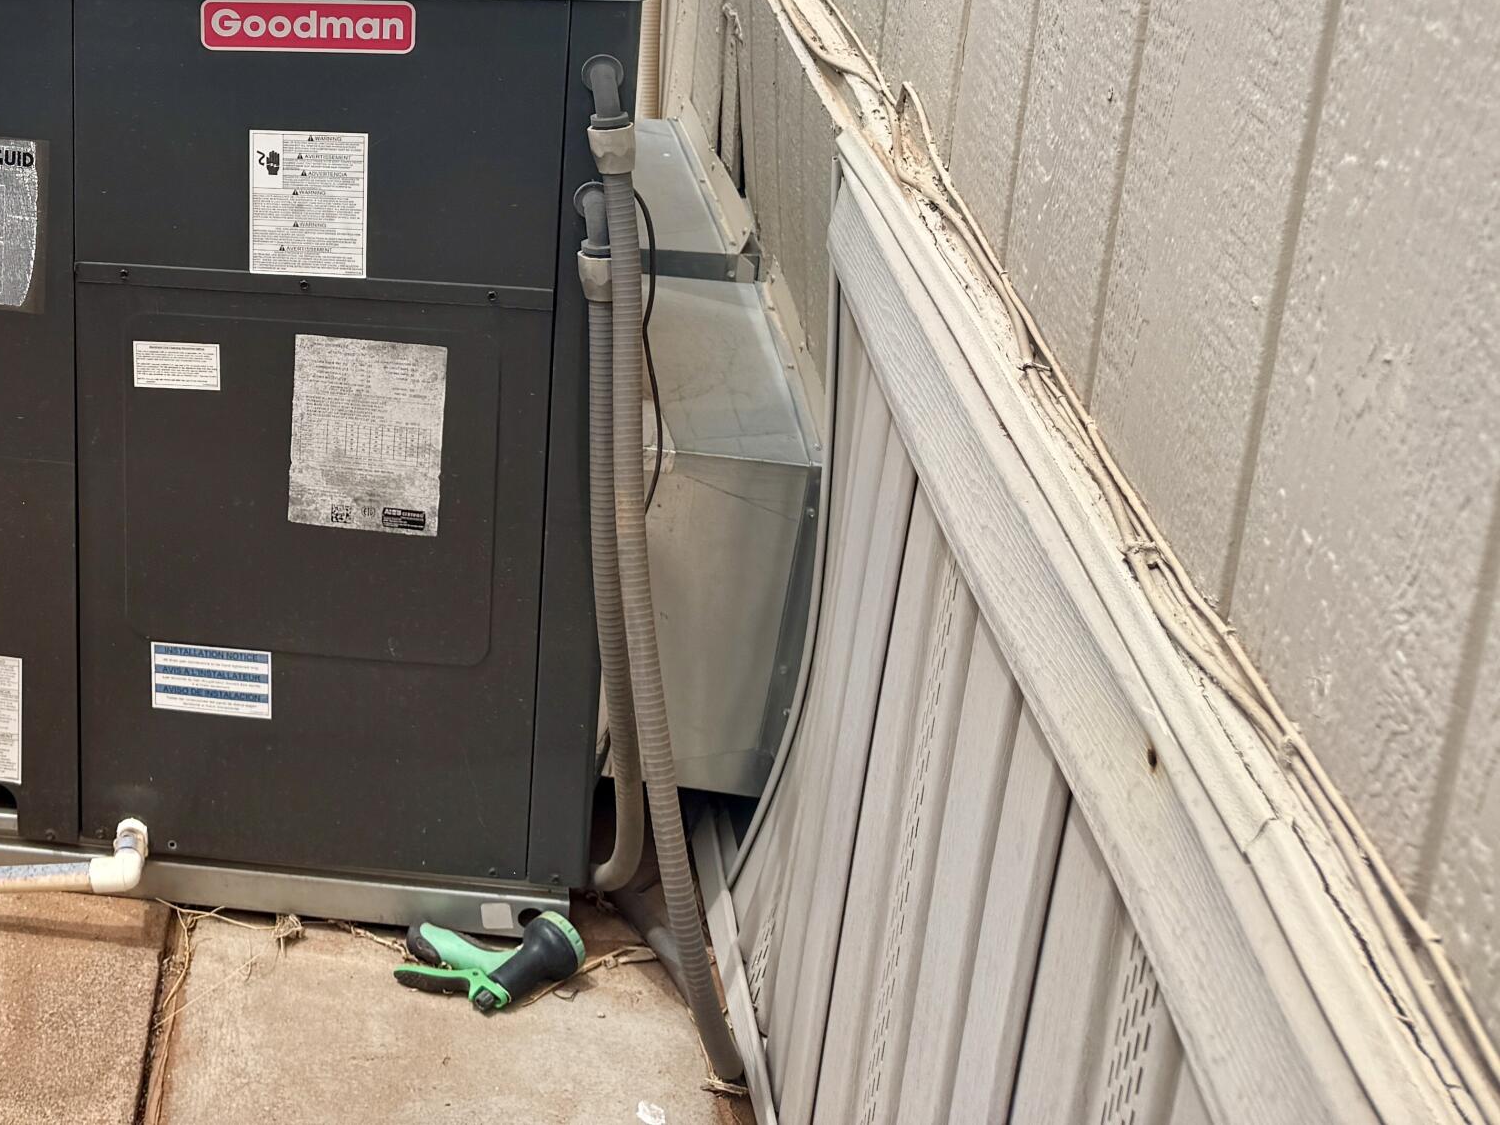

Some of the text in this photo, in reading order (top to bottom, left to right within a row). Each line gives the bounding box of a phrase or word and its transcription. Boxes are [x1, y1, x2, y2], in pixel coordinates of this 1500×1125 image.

[211, 8, 404, 40] Goodman
[164, 646, 259, 662] INSTALLATION NOTICE
[163, 686, 189, 695] AVISO
